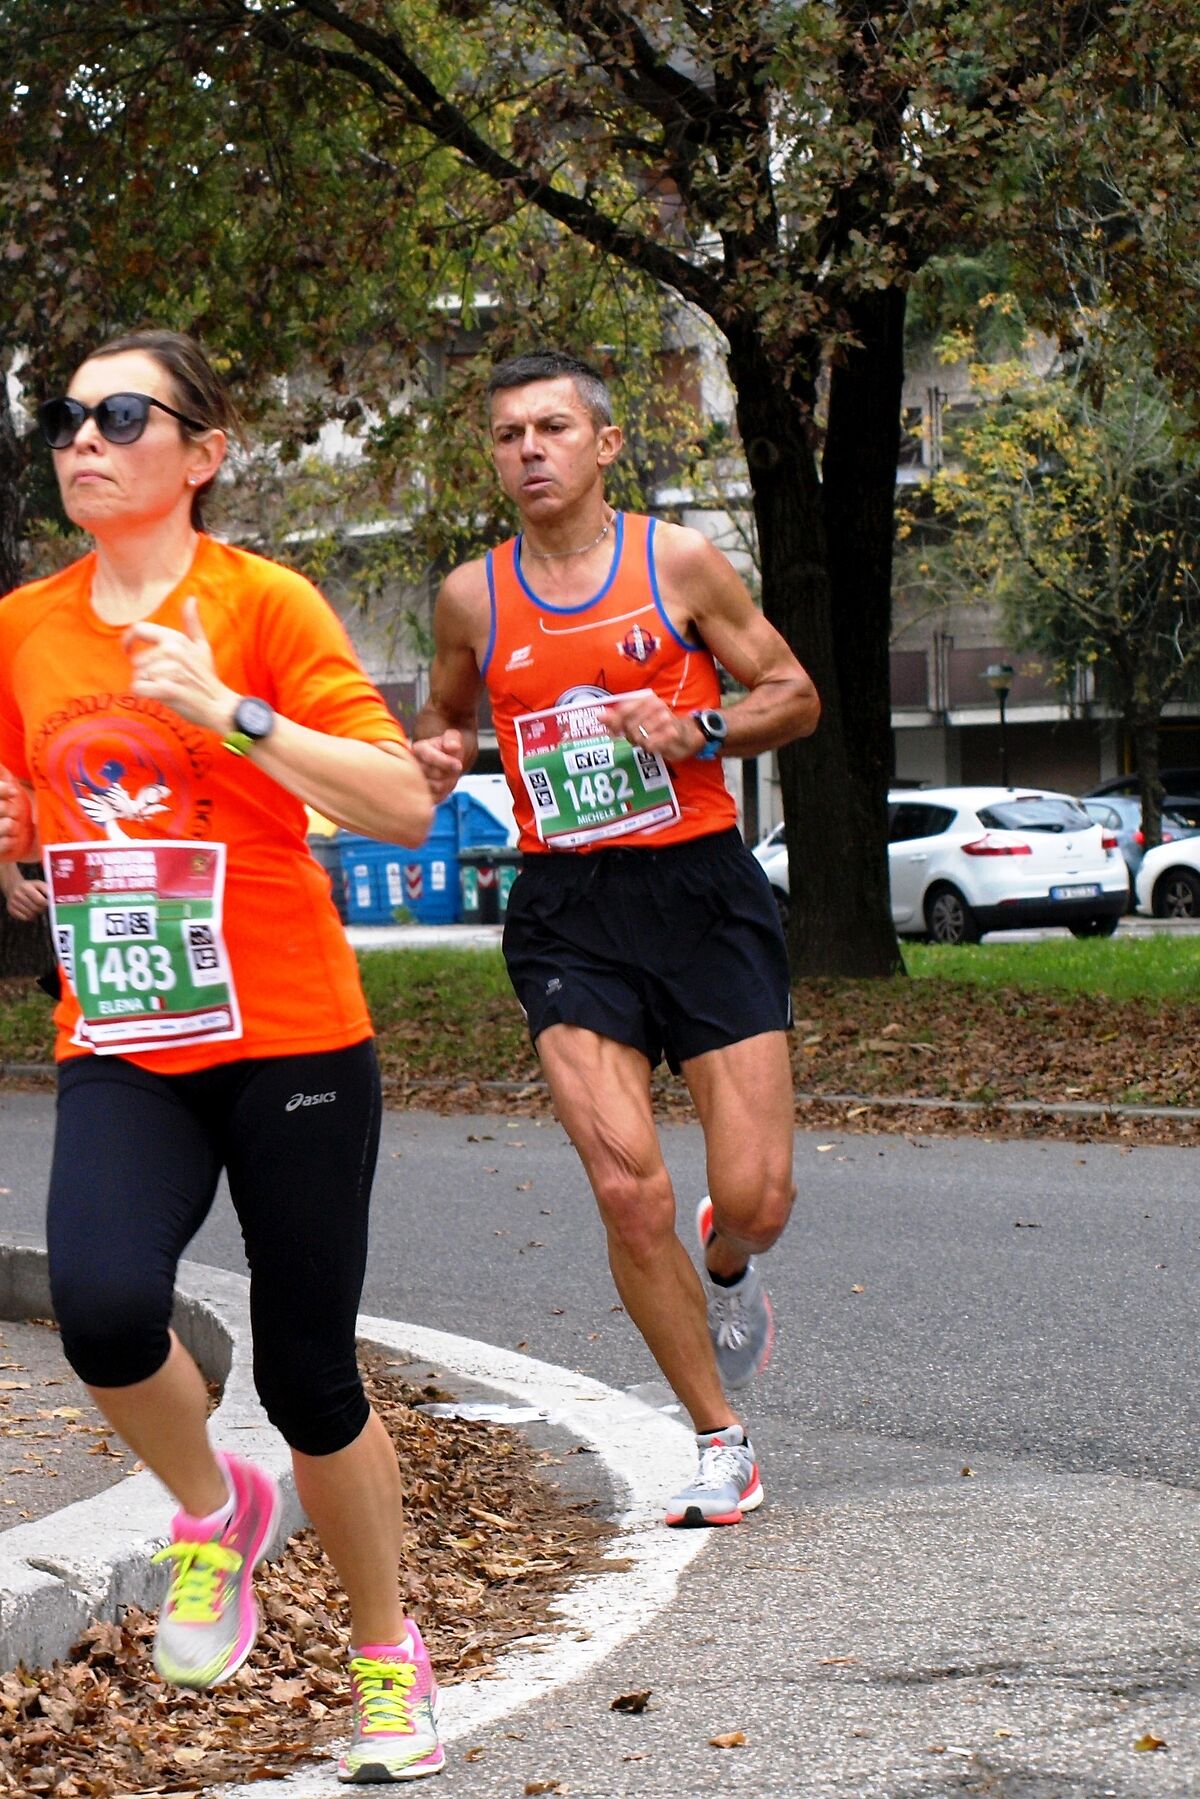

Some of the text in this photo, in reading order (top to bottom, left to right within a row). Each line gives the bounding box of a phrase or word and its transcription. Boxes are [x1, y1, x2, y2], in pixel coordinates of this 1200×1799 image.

[563, 768, 634, 813] 1482
[81, 945, 177, 995] 1483
[97, 998, 145, 1014] ELENA
[298, 1091, 337, 1108] asics
